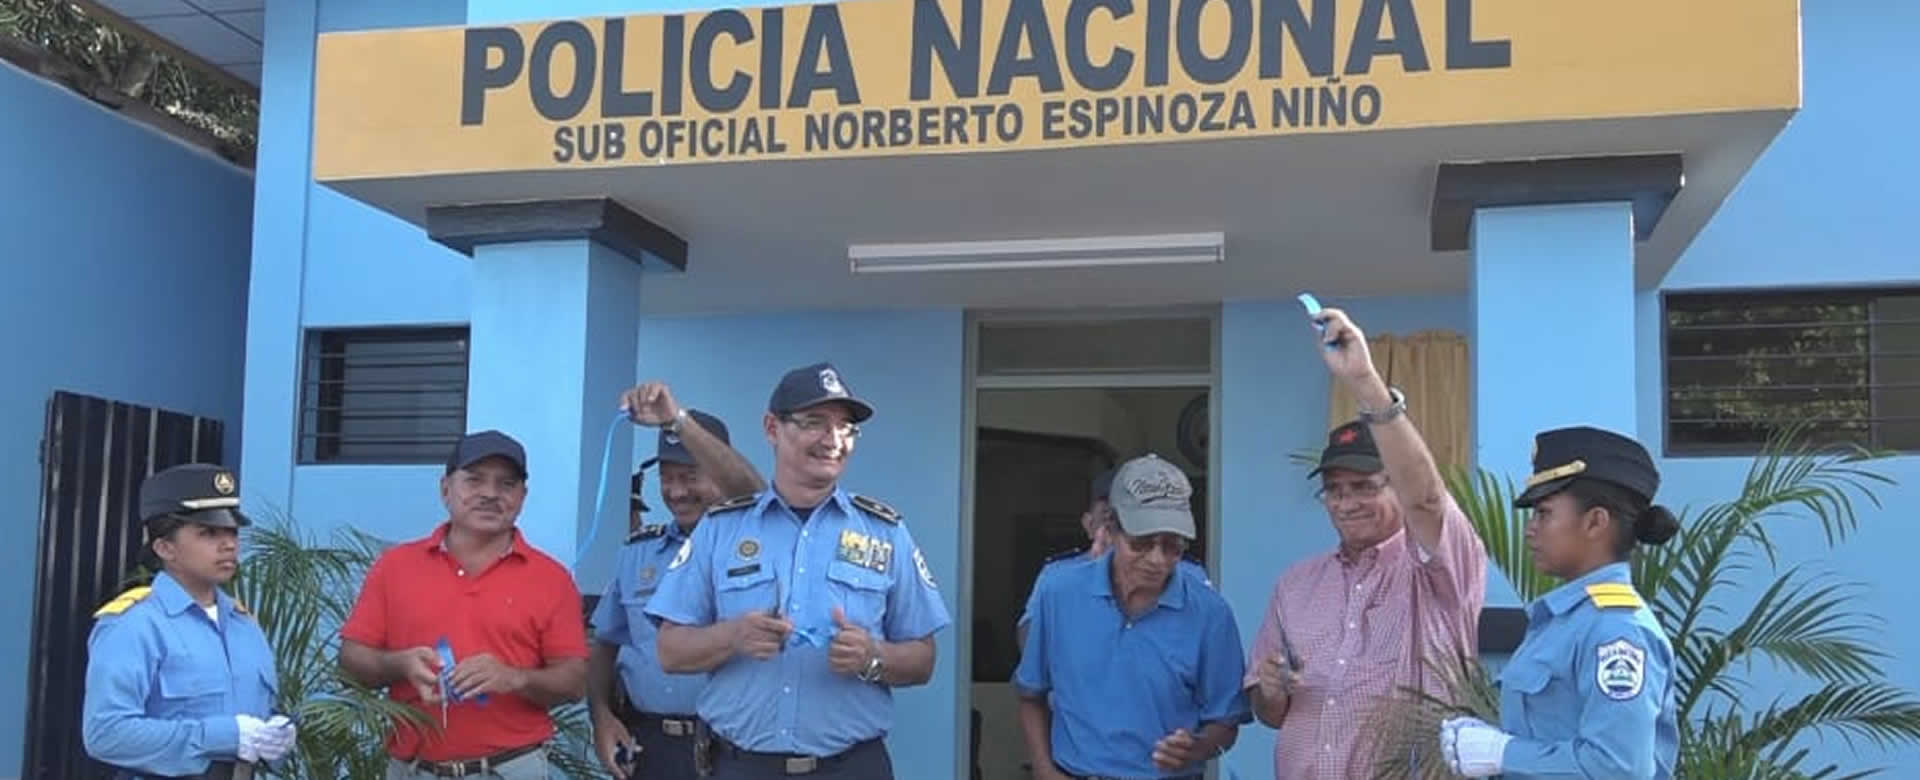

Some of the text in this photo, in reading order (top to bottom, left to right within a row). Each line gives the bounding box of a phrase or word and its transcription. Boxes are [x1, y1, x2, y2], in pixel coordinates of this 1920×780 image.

[461, 0, 1512, 126] POLICIA NACIONAL
[553, 77, 1382, 163] SUB OFICIAL NORBERTO ESPINOZA NIÑO
